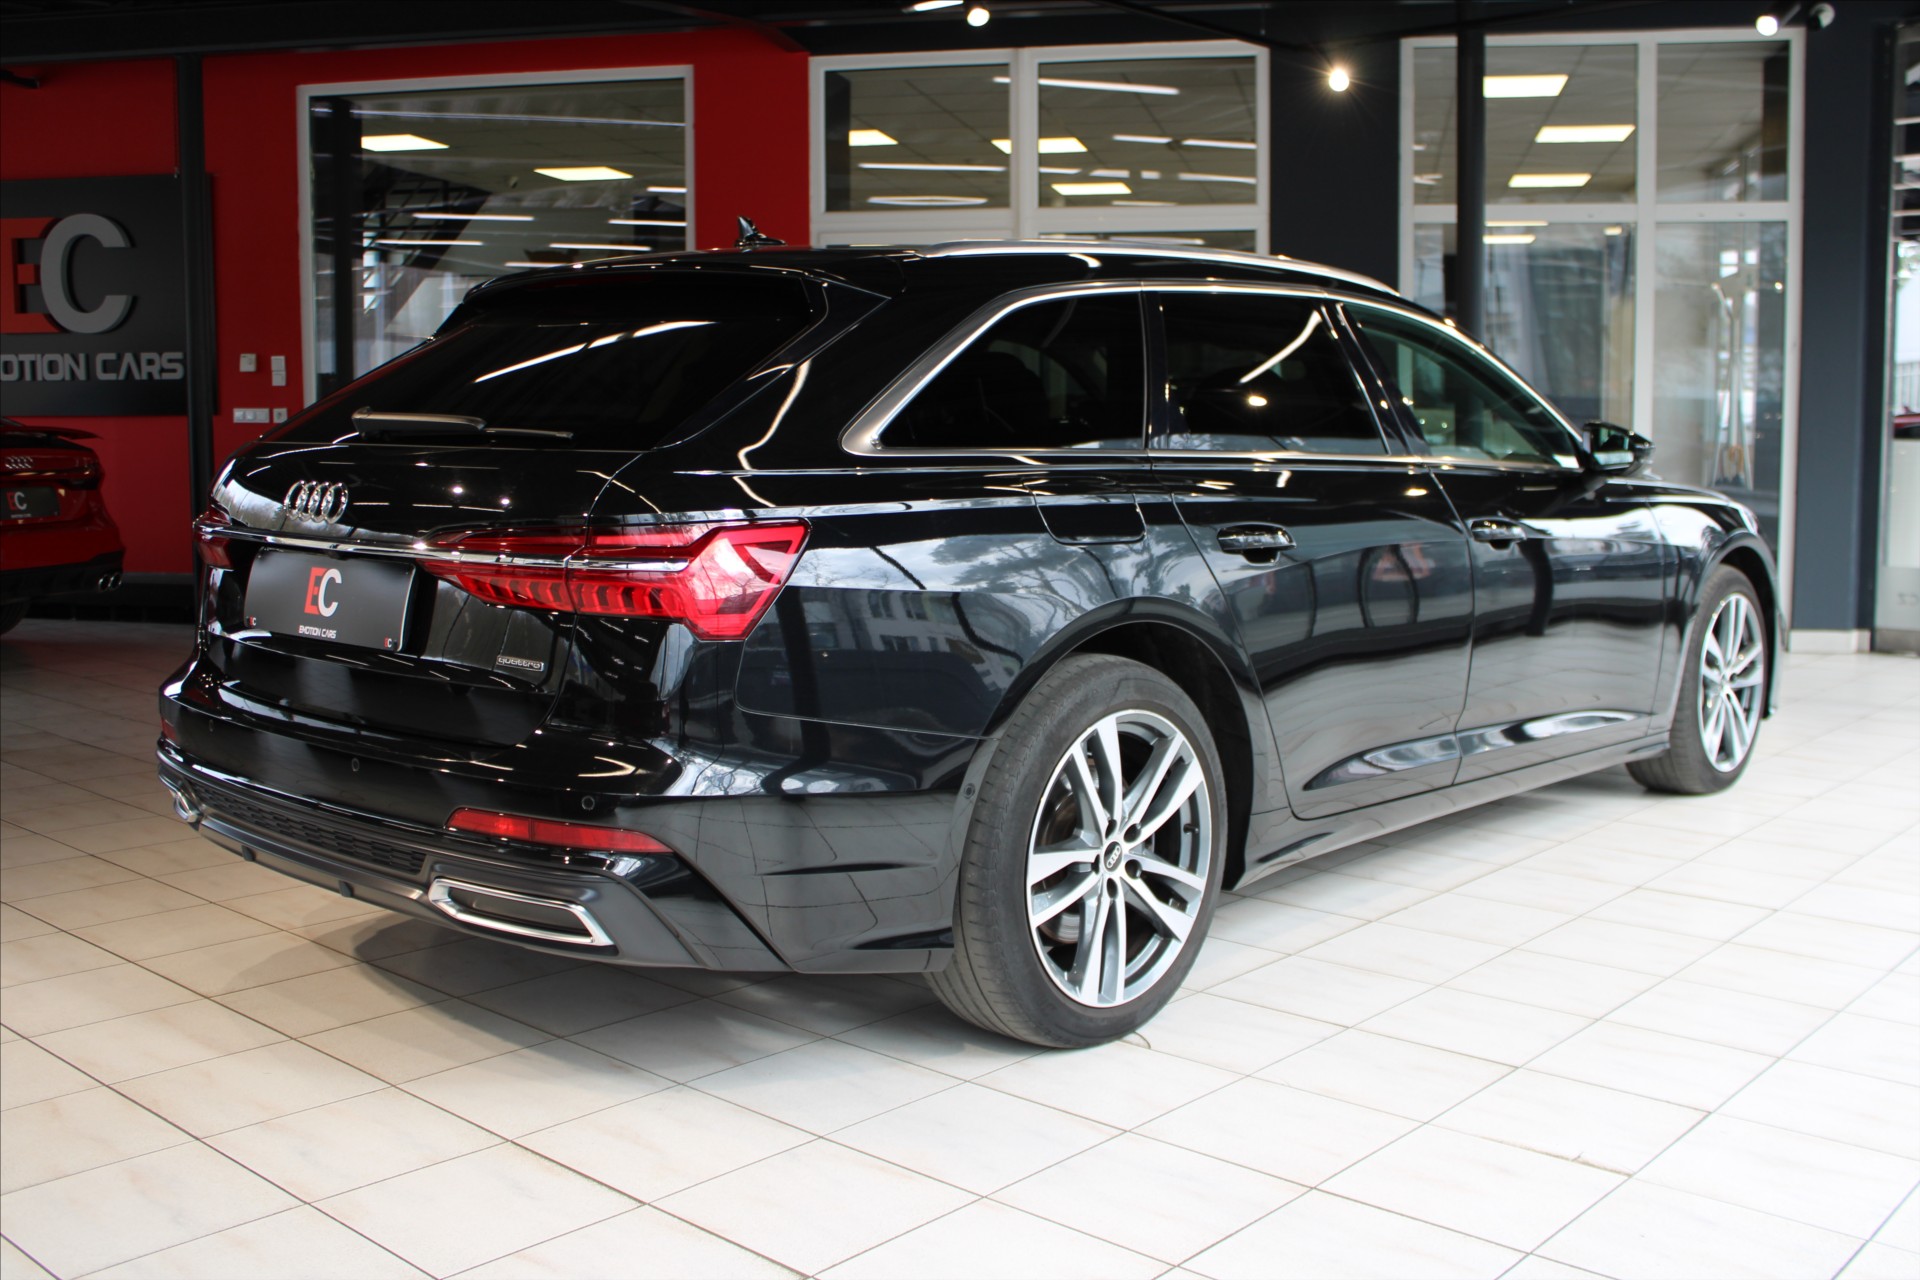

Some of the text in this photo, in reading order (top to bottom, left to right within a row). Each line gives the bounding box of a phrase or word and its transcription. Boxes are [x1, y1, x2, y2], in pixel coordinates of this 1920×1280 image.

[0, 213, 133, 334] EC
[96, 352, 184, 380] CARS
[304, 566, 342, 618] EC
[321, 628, 337, 639] CARS
[498, 657, 541, 669] quattro
